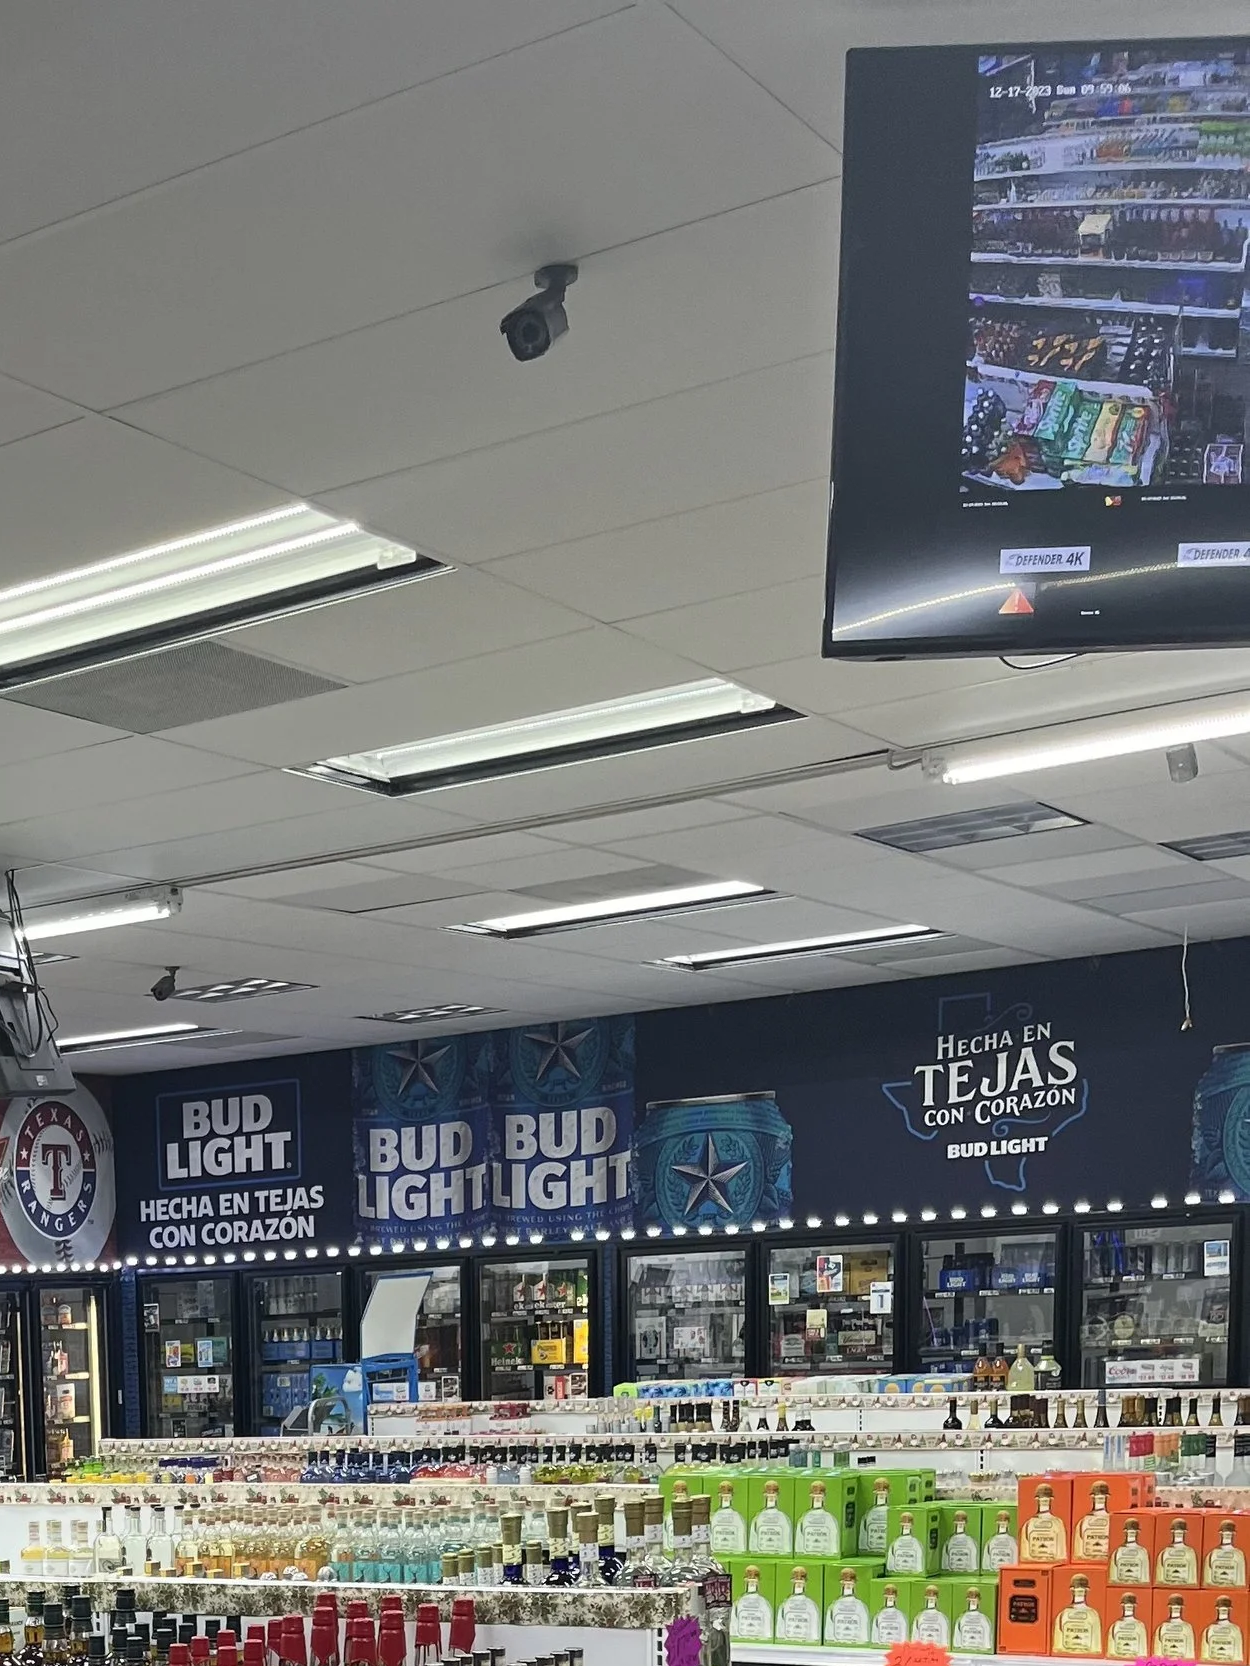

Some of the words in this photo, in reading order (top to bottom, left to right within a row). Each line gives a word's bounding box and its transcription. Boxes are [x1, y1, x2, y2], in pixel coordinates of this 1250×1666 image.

[1016, 554, 1062, 566] DEFENDER
[1066, 552, 1084, 566] 4K
[1194, 549, 1239, 560] DEFENDER
[936, 1028, 1014, 1060] HECHA
[1024, 1022, 1052, 1042] EN
[914, 1040, 1078, 1106] TEJAS
[24, 1108, 85, 1142] TEXAS
[182, 1095, 273, 1139] BUD
[924, 1106, 964, 1127] CON
[974, 1086, 1076, 1126] CORAZÓN
[369, 1121, 473, 1172] BUD
[505, 1106, 617, 1160] BUD
[946, 1139, 988, 1160] BUD
[990, 1136, 1049, 1156] LIGHT
[166, 1132, 292, 1180] LIGHT
[358, 1163, 487, 1221] LIGHT
[492, 1150, 631, 1210] LIGHT
[21, 1180, 94, 1232] RANGERS
[140, 1195, 214, 1222] HECHA
[219, 1191, 250, 1216] EN
[254, 1186, 325, 1214] TEJAS
[149, 1222, 201, 1249] CON
[204, 1210, 315, 1246] CORAZÓN
